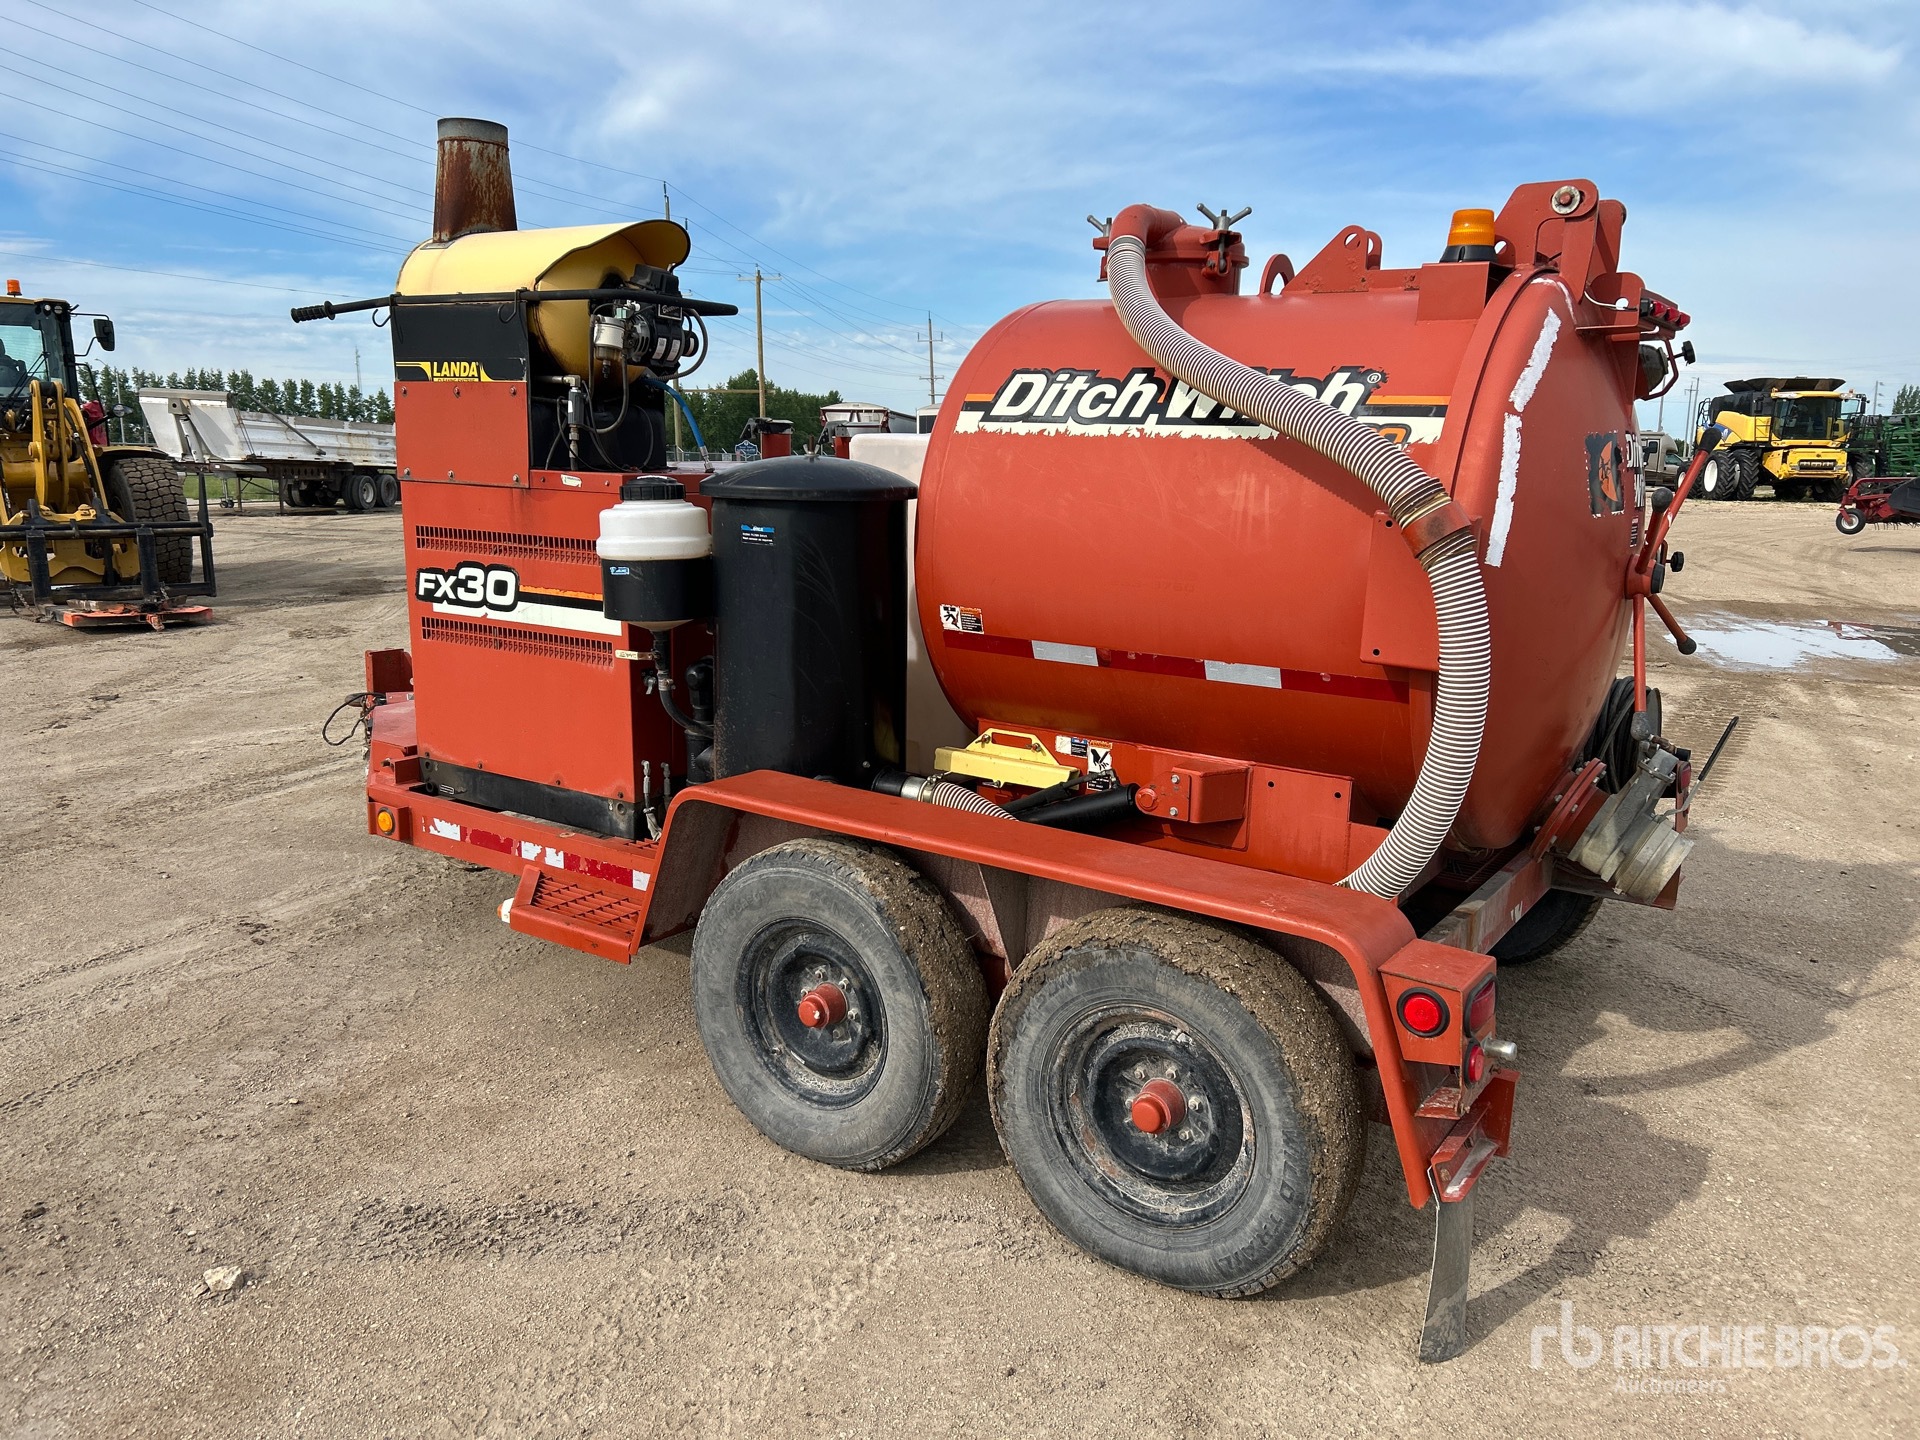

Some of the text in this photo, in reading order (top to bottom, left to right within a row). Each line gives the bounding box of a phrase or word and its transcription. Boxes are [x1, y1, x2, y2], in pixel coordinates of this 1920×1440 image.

[433, 361, 479, 377] LANDA
[990, 373, 1158, 419] Ditch
[418, 566, 516, 606] FX30
